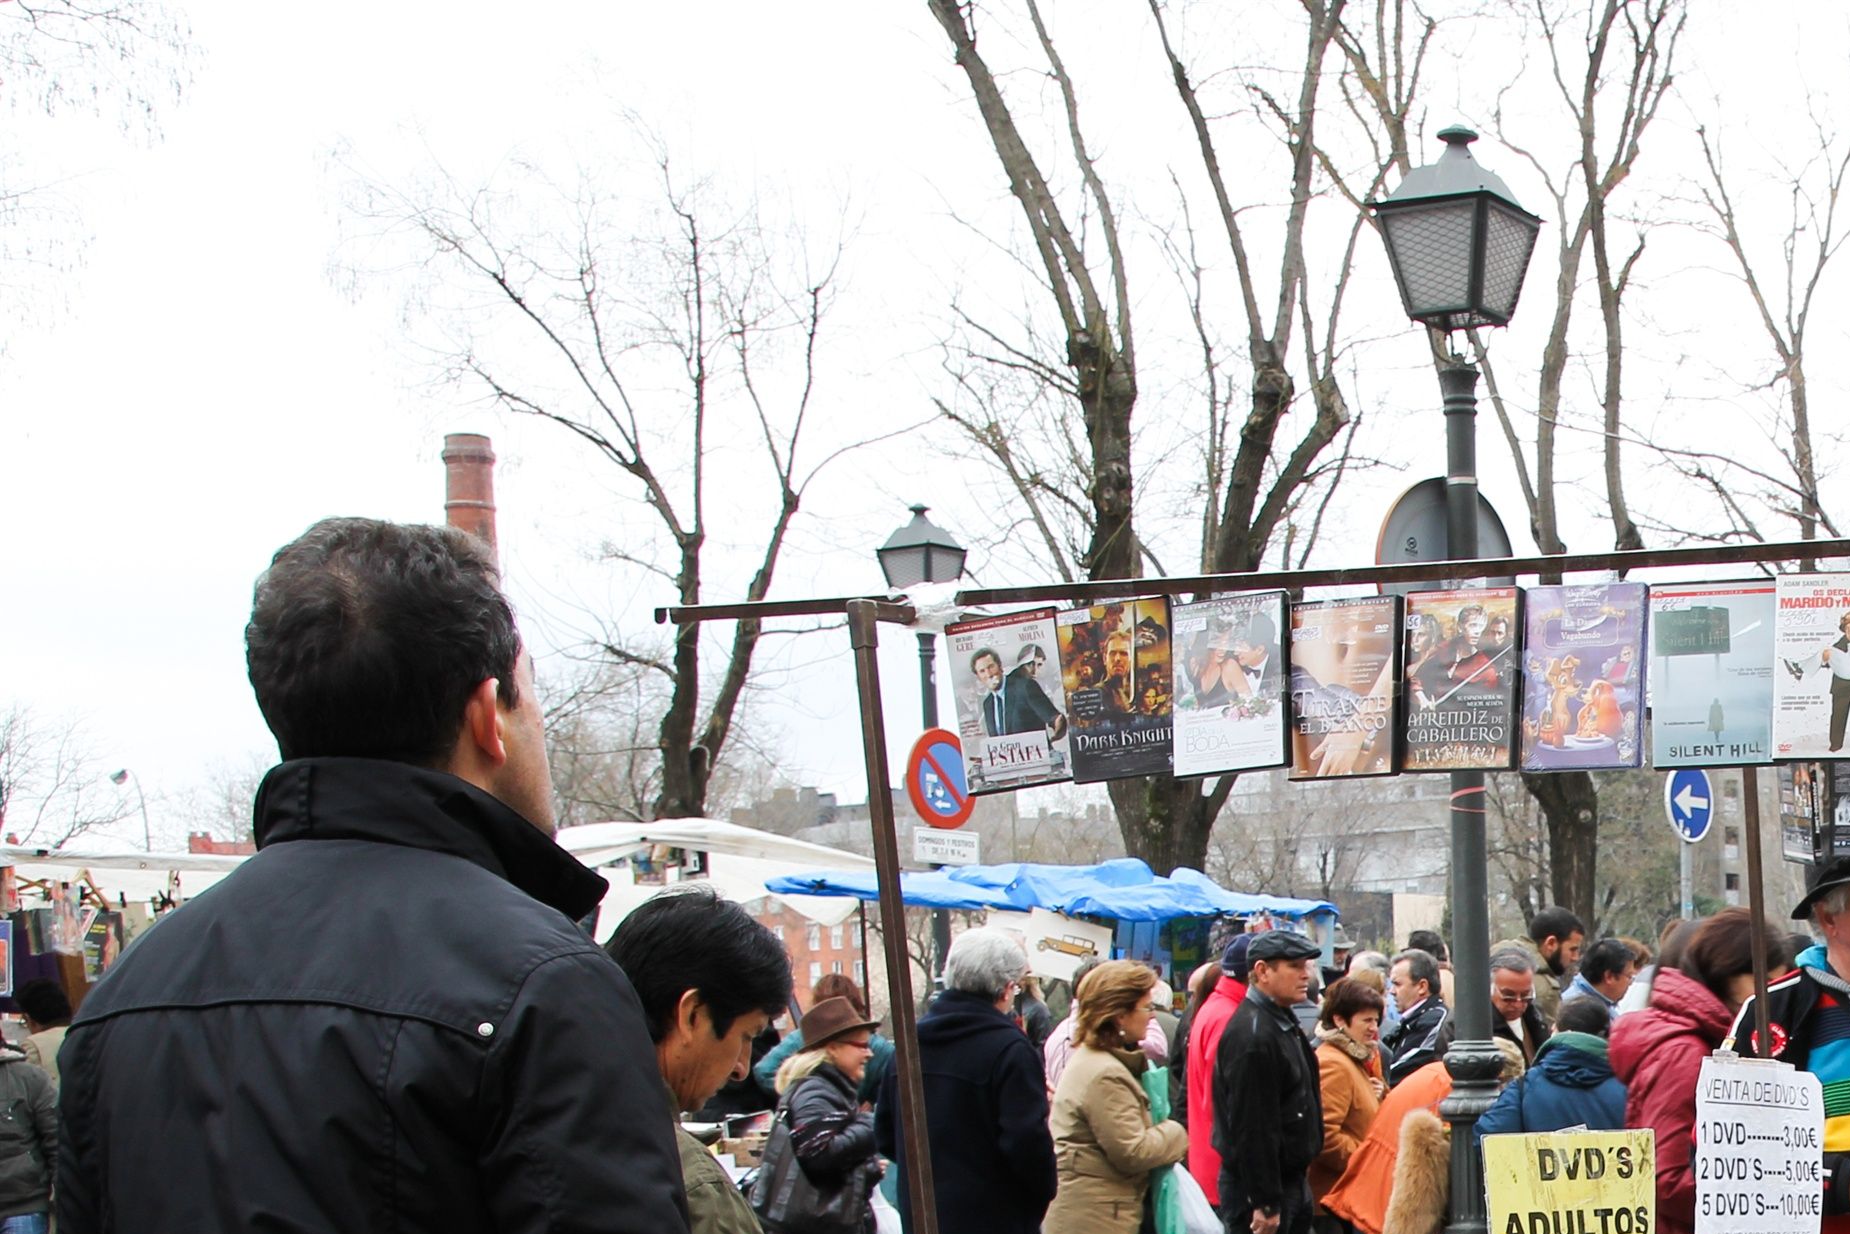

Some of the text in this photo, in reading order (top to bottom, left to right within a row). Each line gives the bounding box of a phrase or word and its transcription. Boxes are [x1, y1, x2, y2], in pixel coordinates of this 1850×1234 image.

[1813, 589, 1824, 597] OS
[1780, 597, 1834, 609] MARIDO
[1835, 600, 1841, 608] Y
[1018, 630, 1045, 641] MOLINA
[1561, 631, 1601, 641] Vagabundo
[956, 642, 974, 652] GERE
[1292, 689, 1387, 718] TIRANTE
[1300, 715, 1387, 735] EL BLANCO
[1491, 715, 1503, 725] DE
[1076, 733, 1118, 751] DARK
[1121, 727, 1173, 746] KNIGHT
[1406, 726, 1504, 743] CABALLERO
[987, 741, 1020, 753] La Gran
[1185, 735, 1231, 753] BODA
[1669, 742, 1762, 759] SILENT HILL
[989, 745, 1042, 766] ESTAFA
[1705, 1079, 1750, 1101] VENTA
[1754, 1082, 1771, 1103] DE
[1701, 1121, 1707, 1144] 1
[1701, 1157, 1708, 1180] 2
[1702, 1193, 1711, 1216] 5
